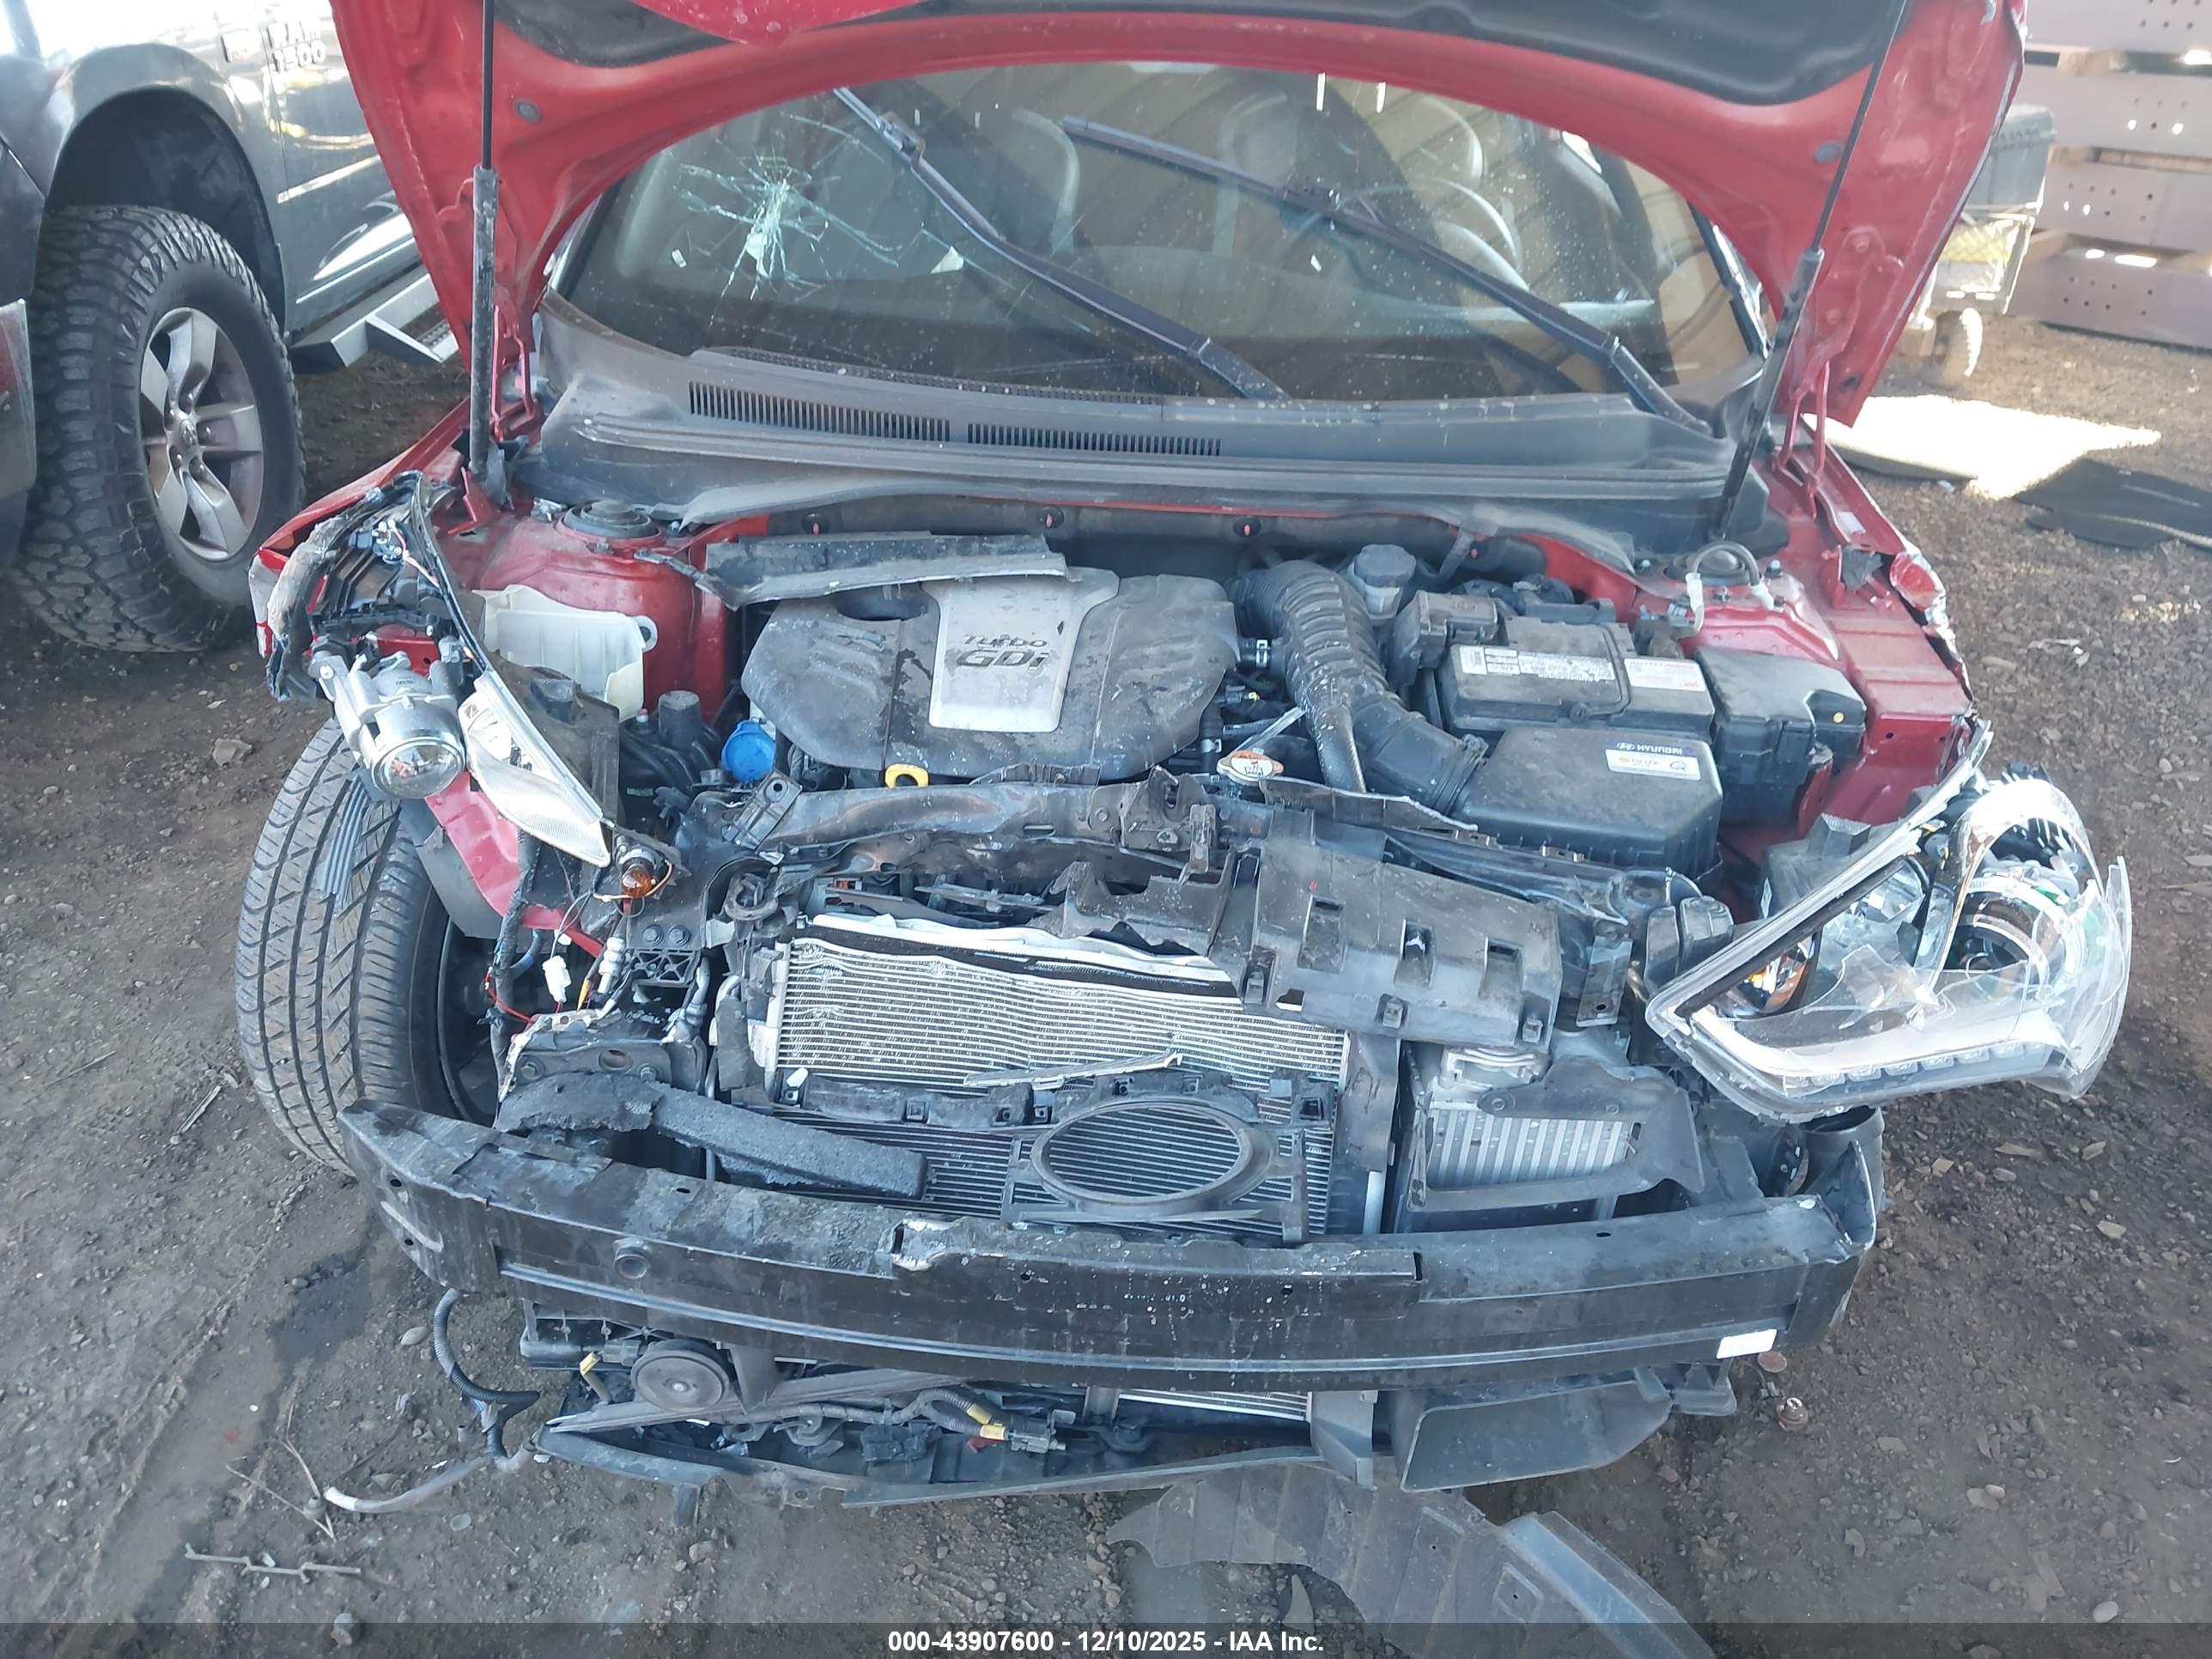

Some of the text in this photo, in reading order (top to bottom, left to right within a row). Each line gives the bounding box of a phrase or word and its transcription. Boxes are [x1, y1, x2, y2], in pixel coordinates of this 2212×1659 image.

[271, 40, 325, 72] 1500
[956, 648, 1049, 668] GDi
[1637, 744, 1683, 756] HYUNDAI
